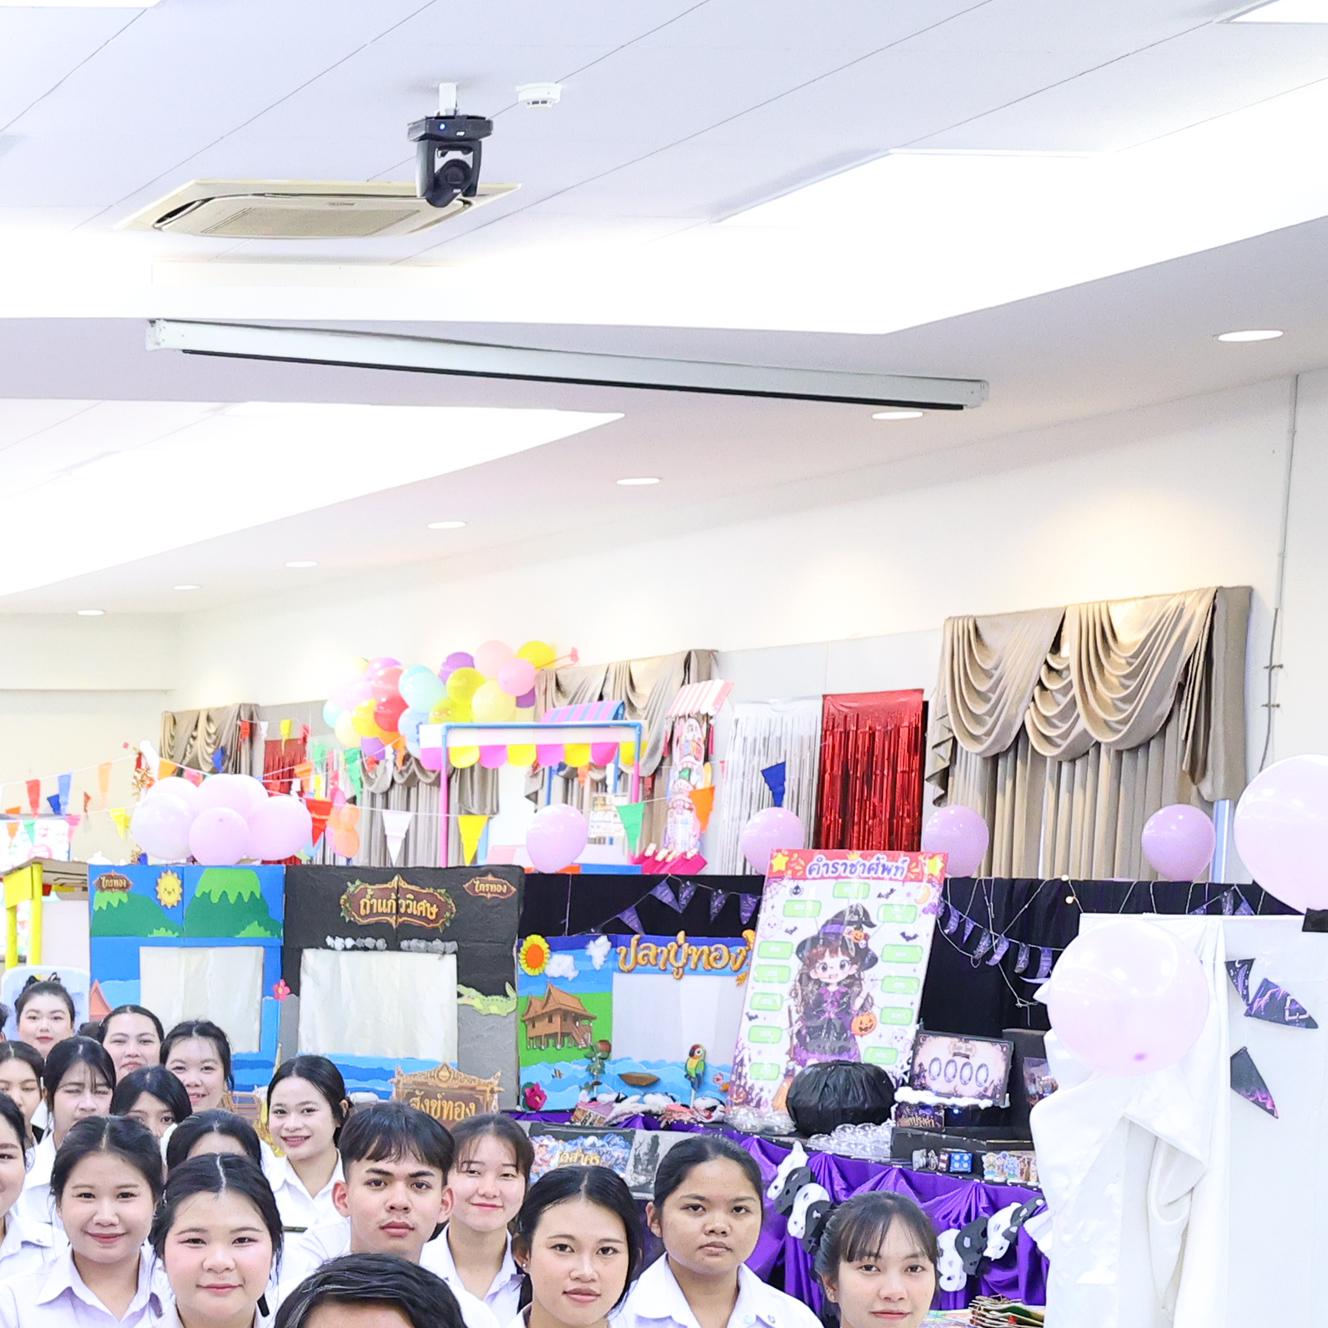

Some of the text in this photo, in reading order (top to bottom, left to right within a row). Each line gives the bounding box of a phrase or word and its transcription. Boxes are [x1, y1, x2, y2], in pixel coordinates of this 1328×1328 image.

[807, 856, 907, 878] คำราชาศัพท์
[474, 879, 507, 894] ไกรทอง
[617, 930, 747, 980] ปลาบู่ทอง
